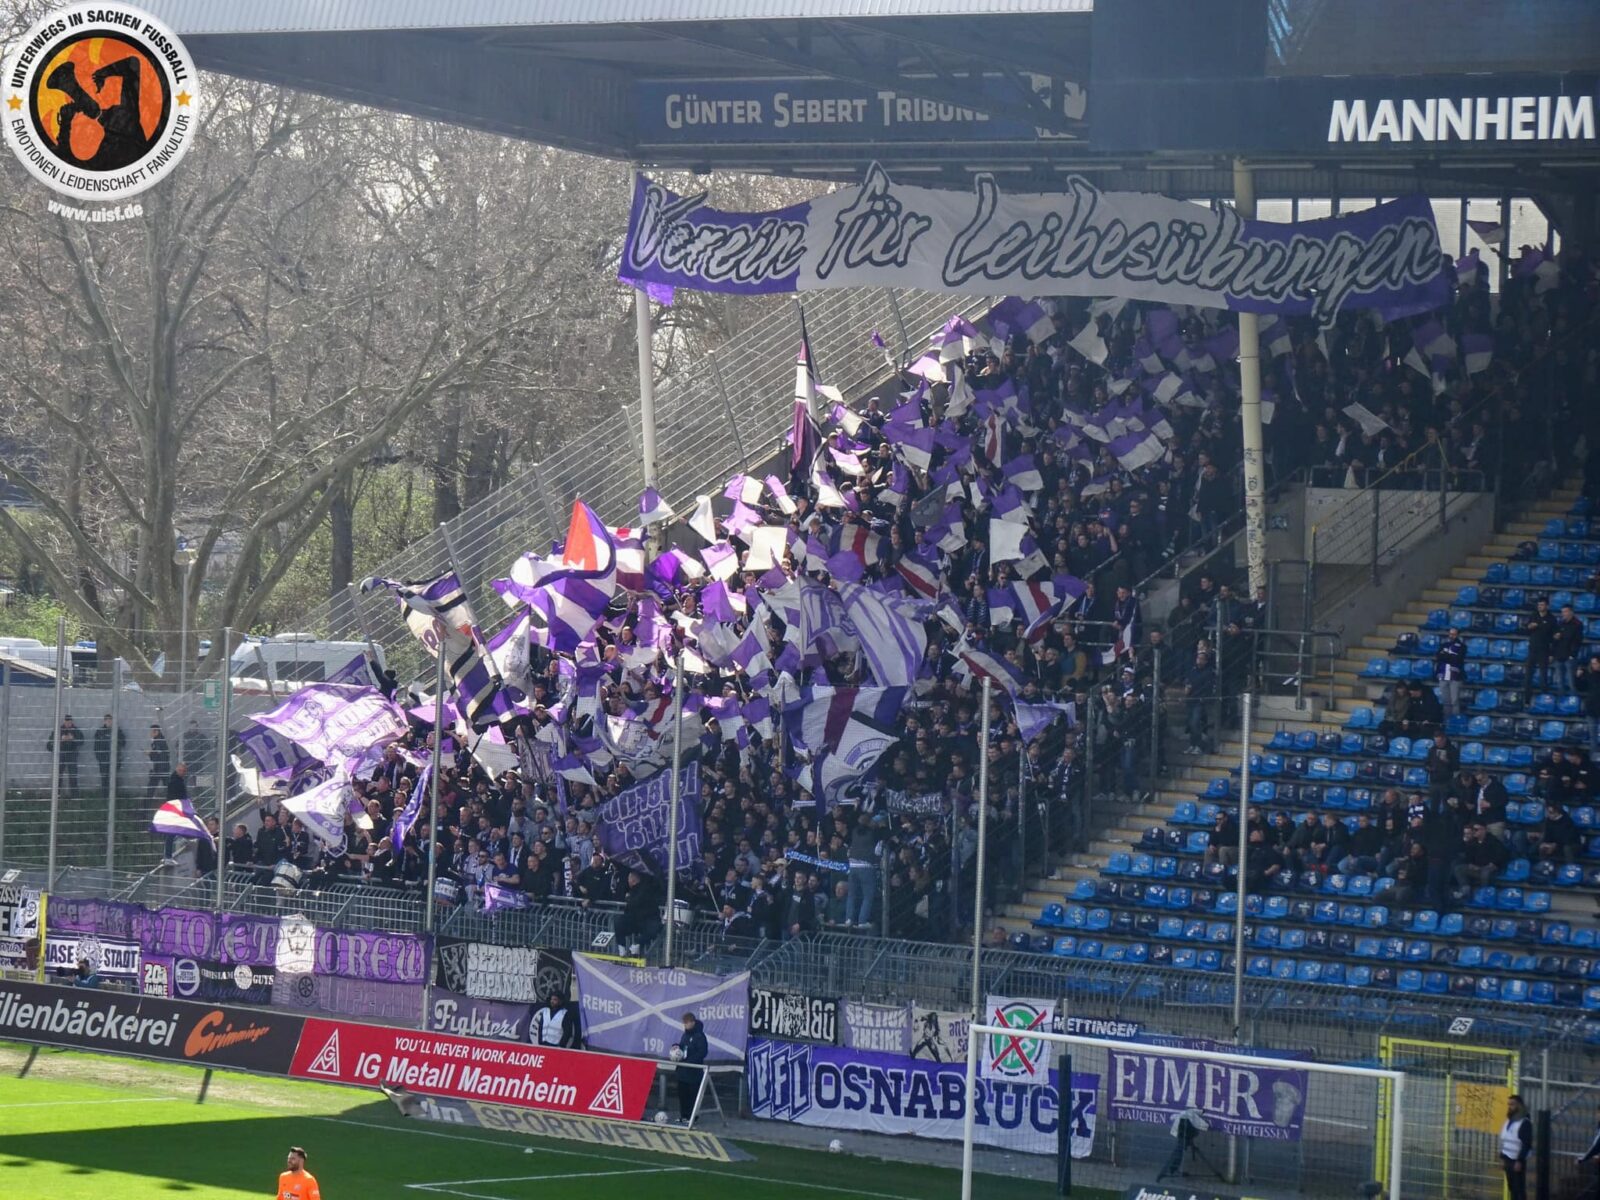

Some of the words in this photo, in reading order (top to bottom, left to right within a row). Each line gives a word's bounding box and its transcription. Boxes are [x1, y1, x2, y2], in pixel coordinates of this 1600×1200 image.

[665, 94, 763, 129] GÜNTER
[774, 93, 867, 128] SEBERT
[1328, 96, 1596, 142] MANNHEIM
[628, 183, 807, 285] Verein
[815, 159, 932, 280] für
[942, 172, 1444, 331] Leibesübungen
[318, 931, 425, 980] CREW
[596, 933, 611, 944] 26
[104, 948, 138, 968] STADT
[144, 984, 169, 996] JAHRE
[434, 1000, 521, 1039] Fighters
[1053, 1015, 1138, 1037] METTINGEN
[1451, 1018, 1470, 1033] 25
[433, 1041, 468, 1059] NEVER
[470, 1046, 507, 1065] WORK
[506, 1051, 545, 1069] ALONE
[353, 1051, 382, 1080] IG
[385, 1055, 455, 1090] Metall
[457, 1065, 577, 1106] Mannheim
[1113, 1053, 1263, 1119] EIMER
[480, 1106, 722, 1158] SPORTWETTEN
[1118, 1108, 1167, 1125] RAUCHEN
